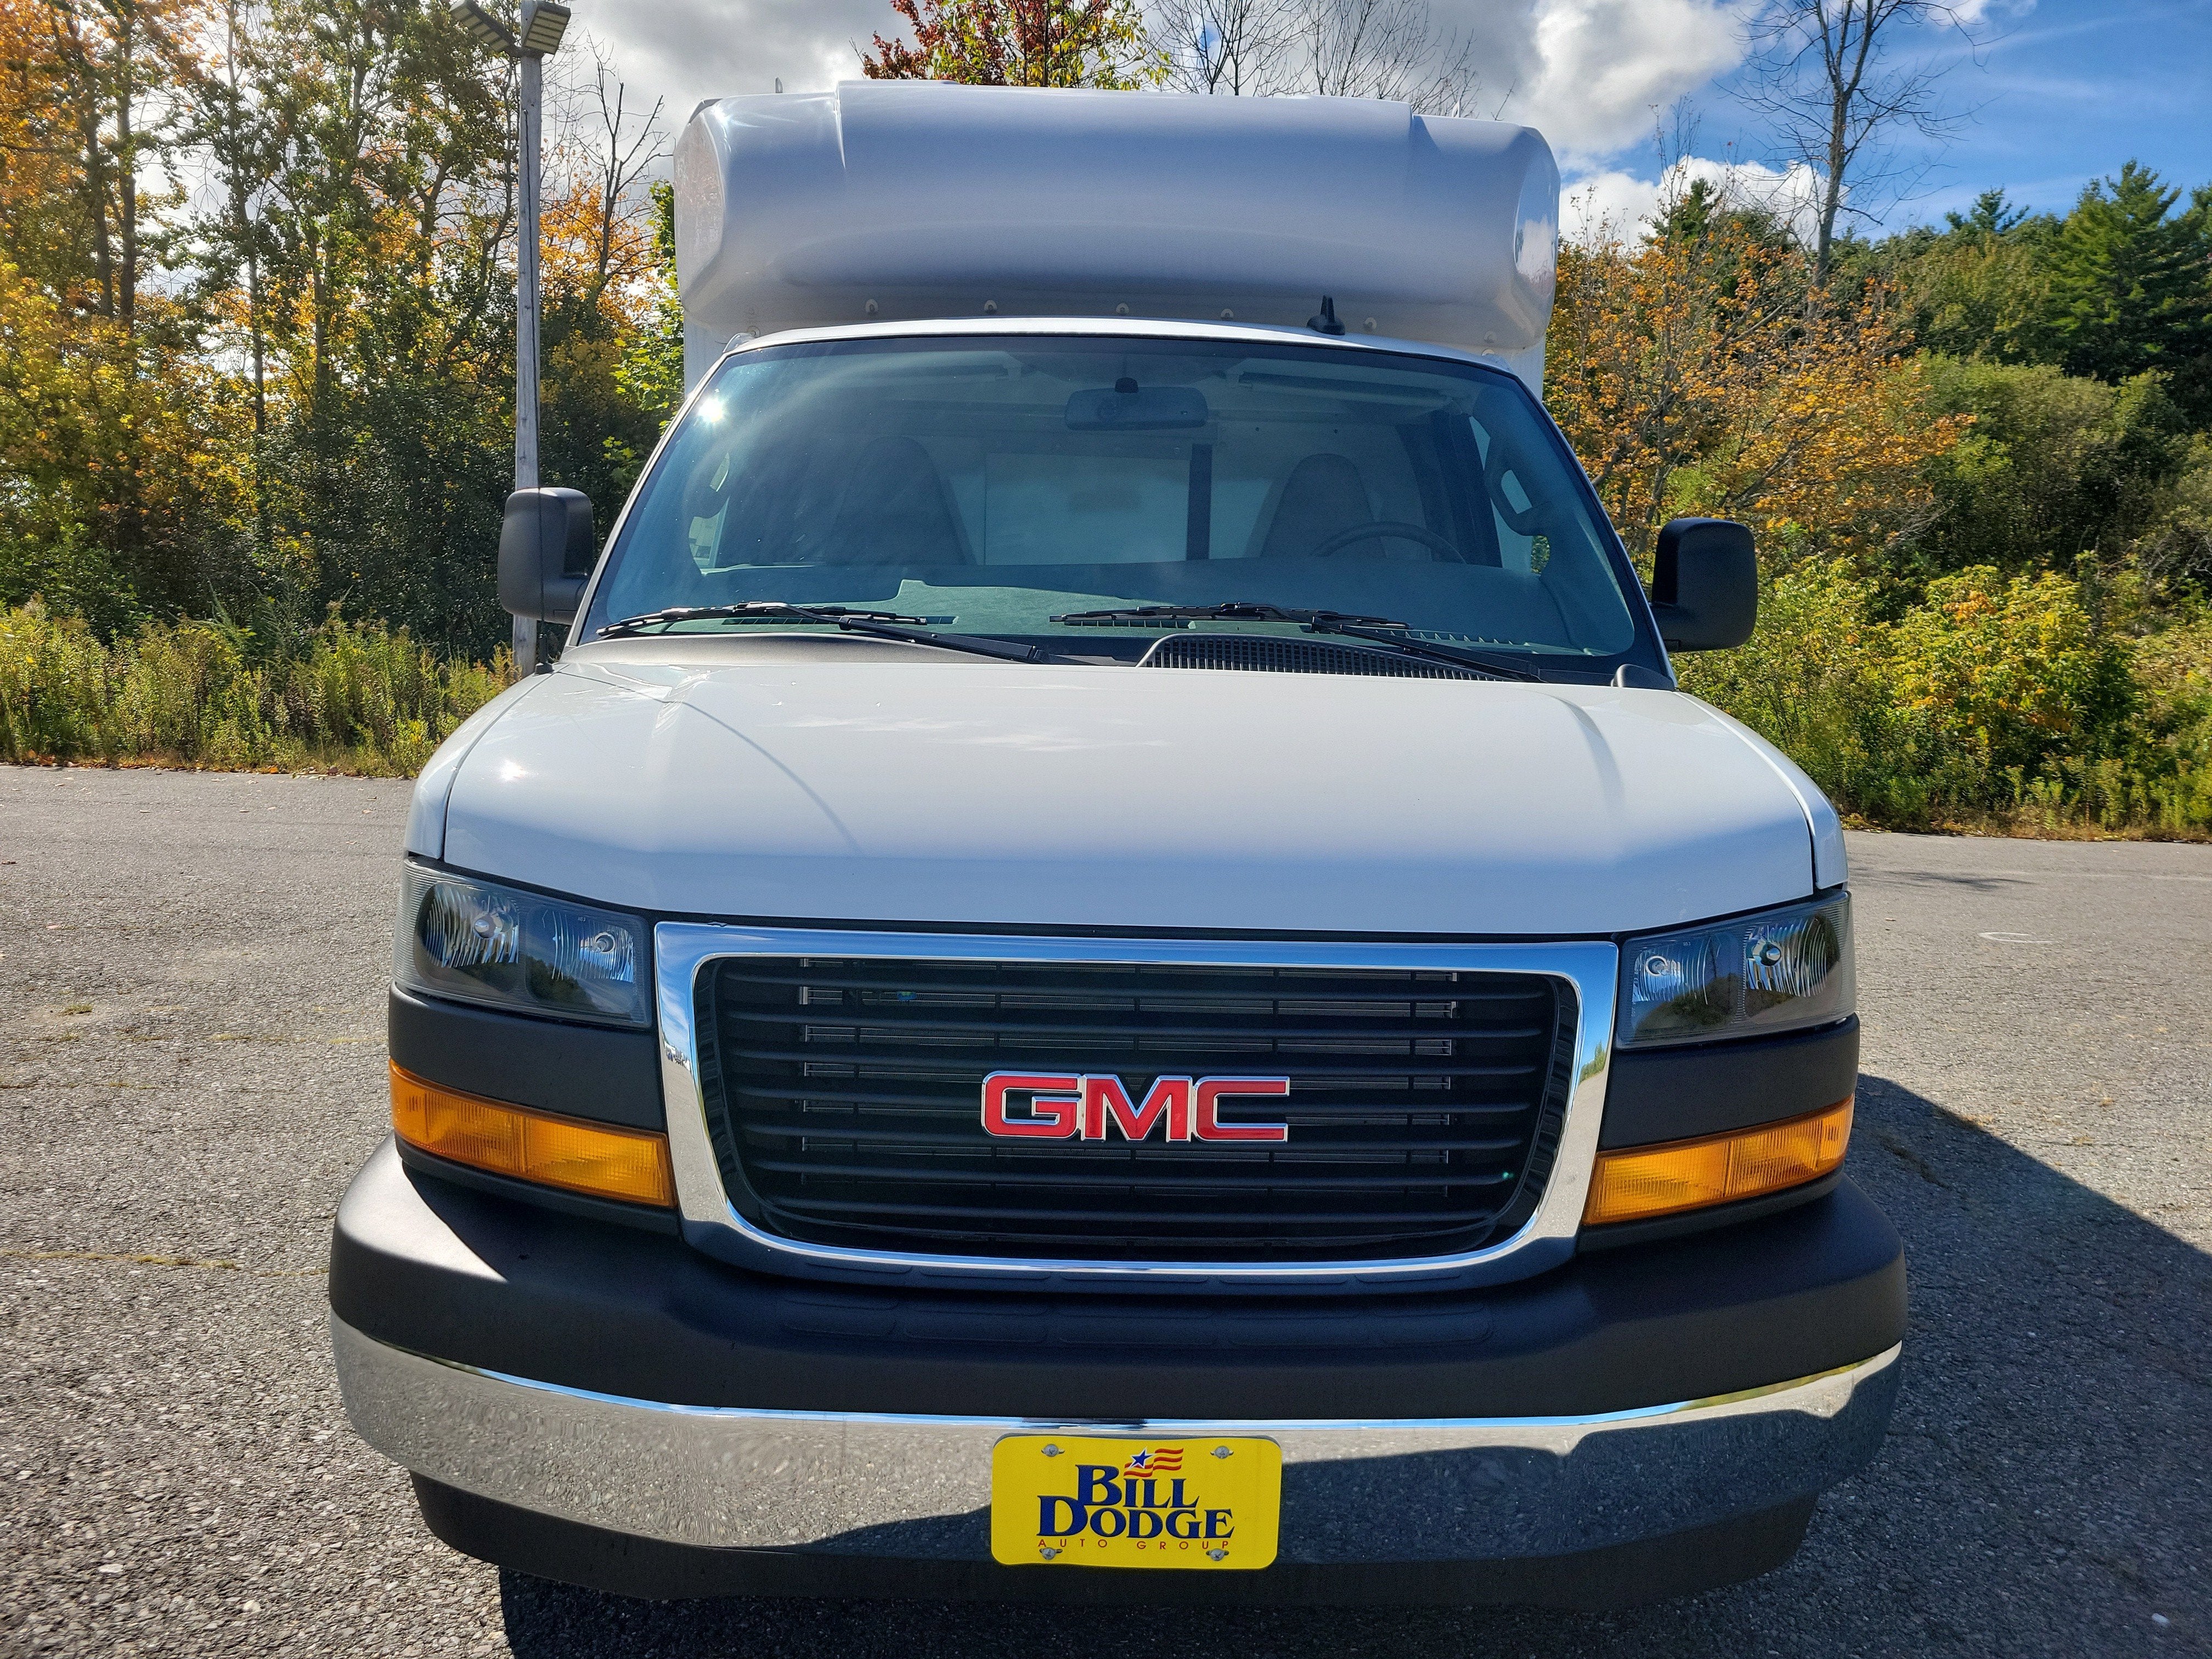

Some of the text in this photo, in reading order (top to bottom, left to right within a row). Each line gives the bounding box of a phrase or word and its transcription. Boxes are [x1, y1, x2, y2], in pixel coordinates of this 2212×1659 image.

[981, 1070, 1290, 1143] GMC
[1075, 1464, 1200, 1508] BILL
[1036, 1494, 1235, 1538] DODGE
[1038, 1539, 1229, 1550] AUTO GROUP
